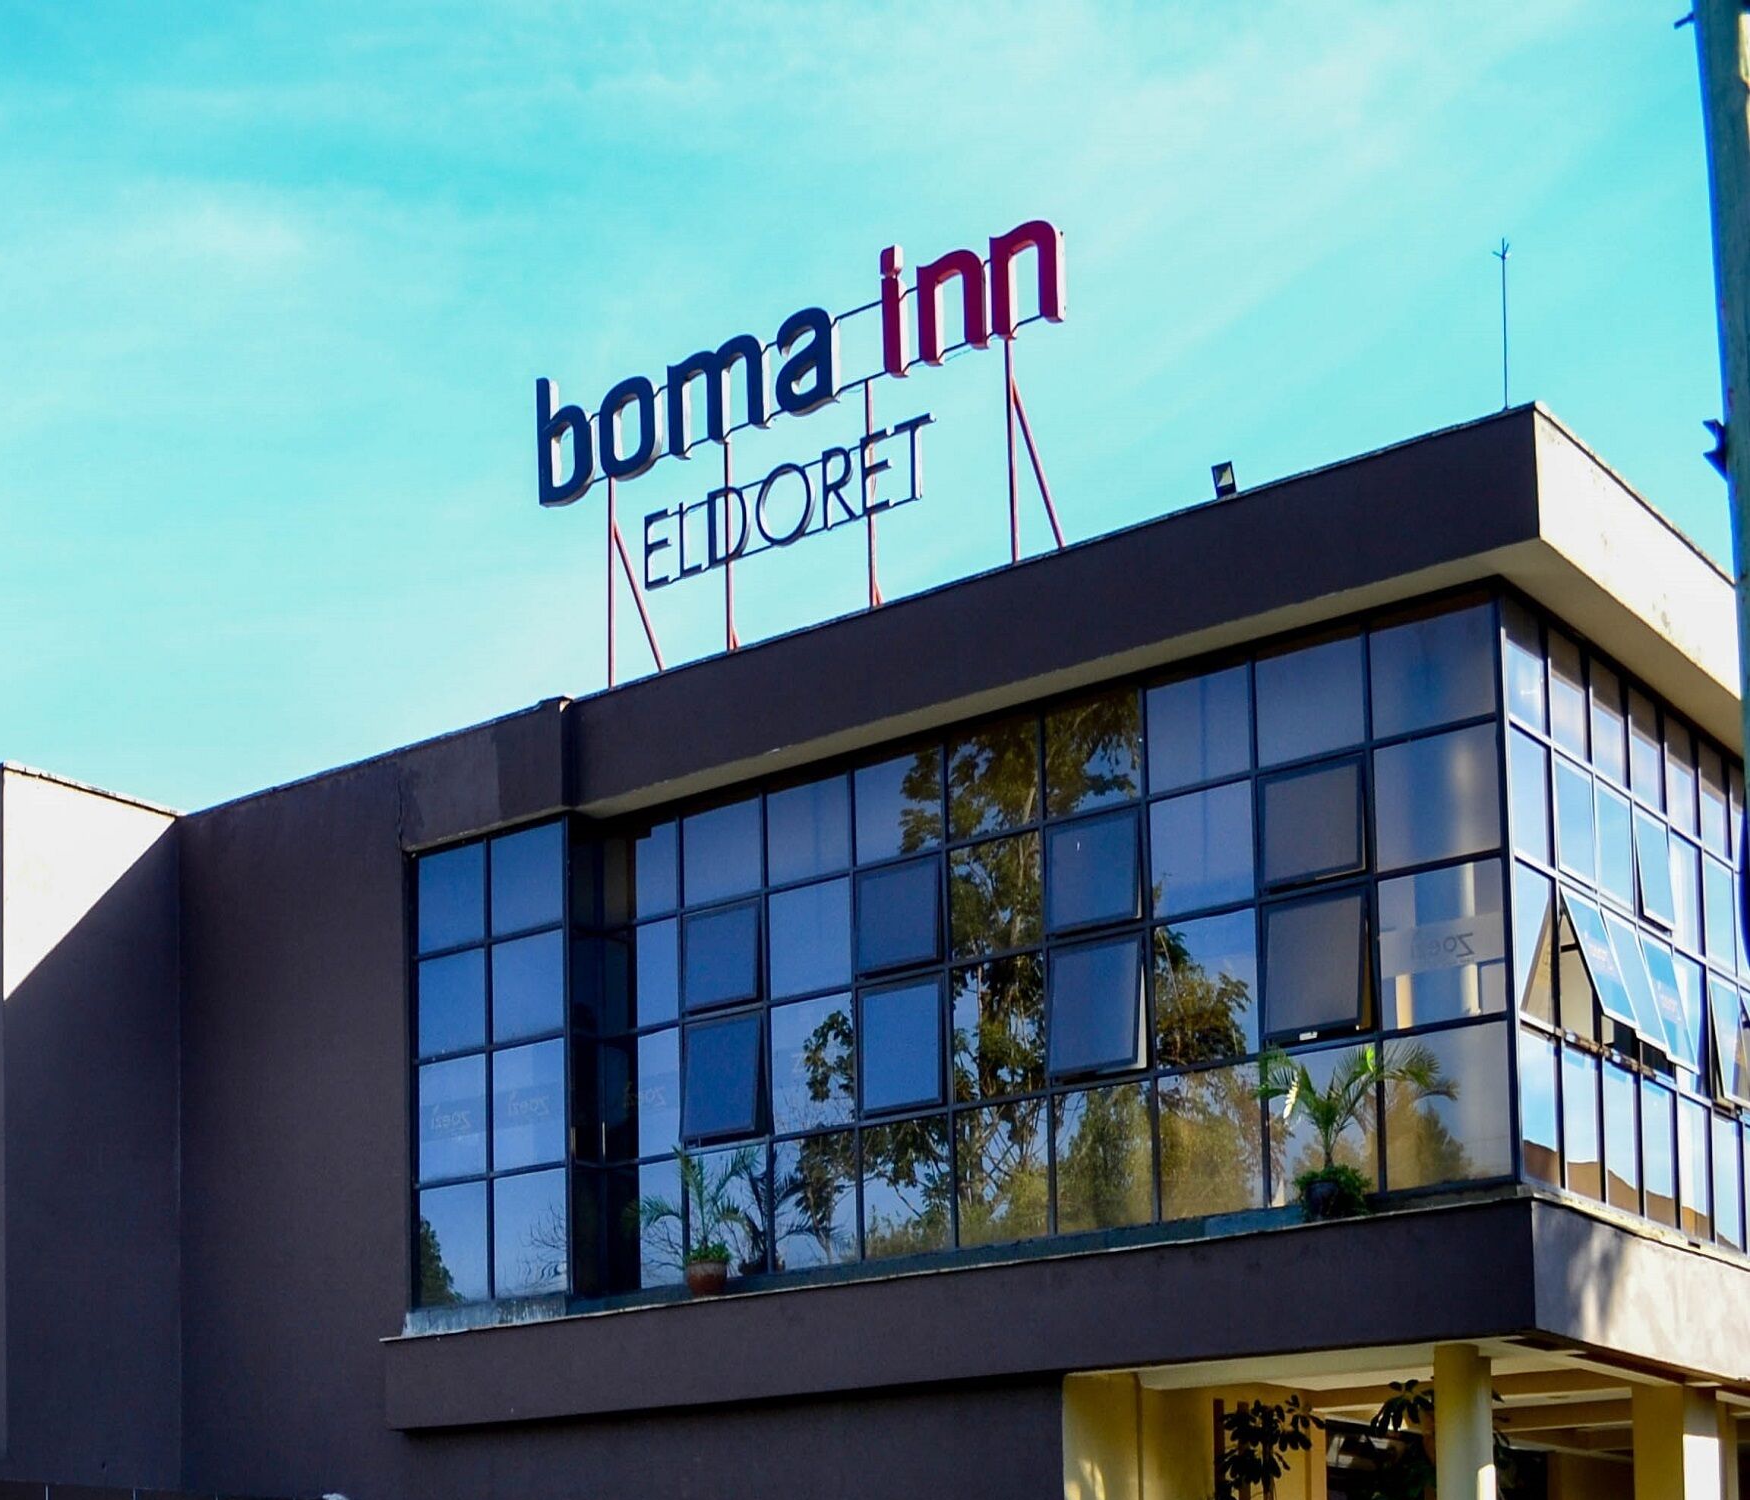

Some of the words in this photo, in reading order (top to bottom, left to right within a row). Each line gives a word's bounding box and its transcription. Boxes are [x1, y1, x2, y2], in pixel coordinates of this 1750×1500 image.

[536, 307, 840, 507] boma
[880, 220, 1065, 378] inn
[644, 413, 936, 590] ELDORET
